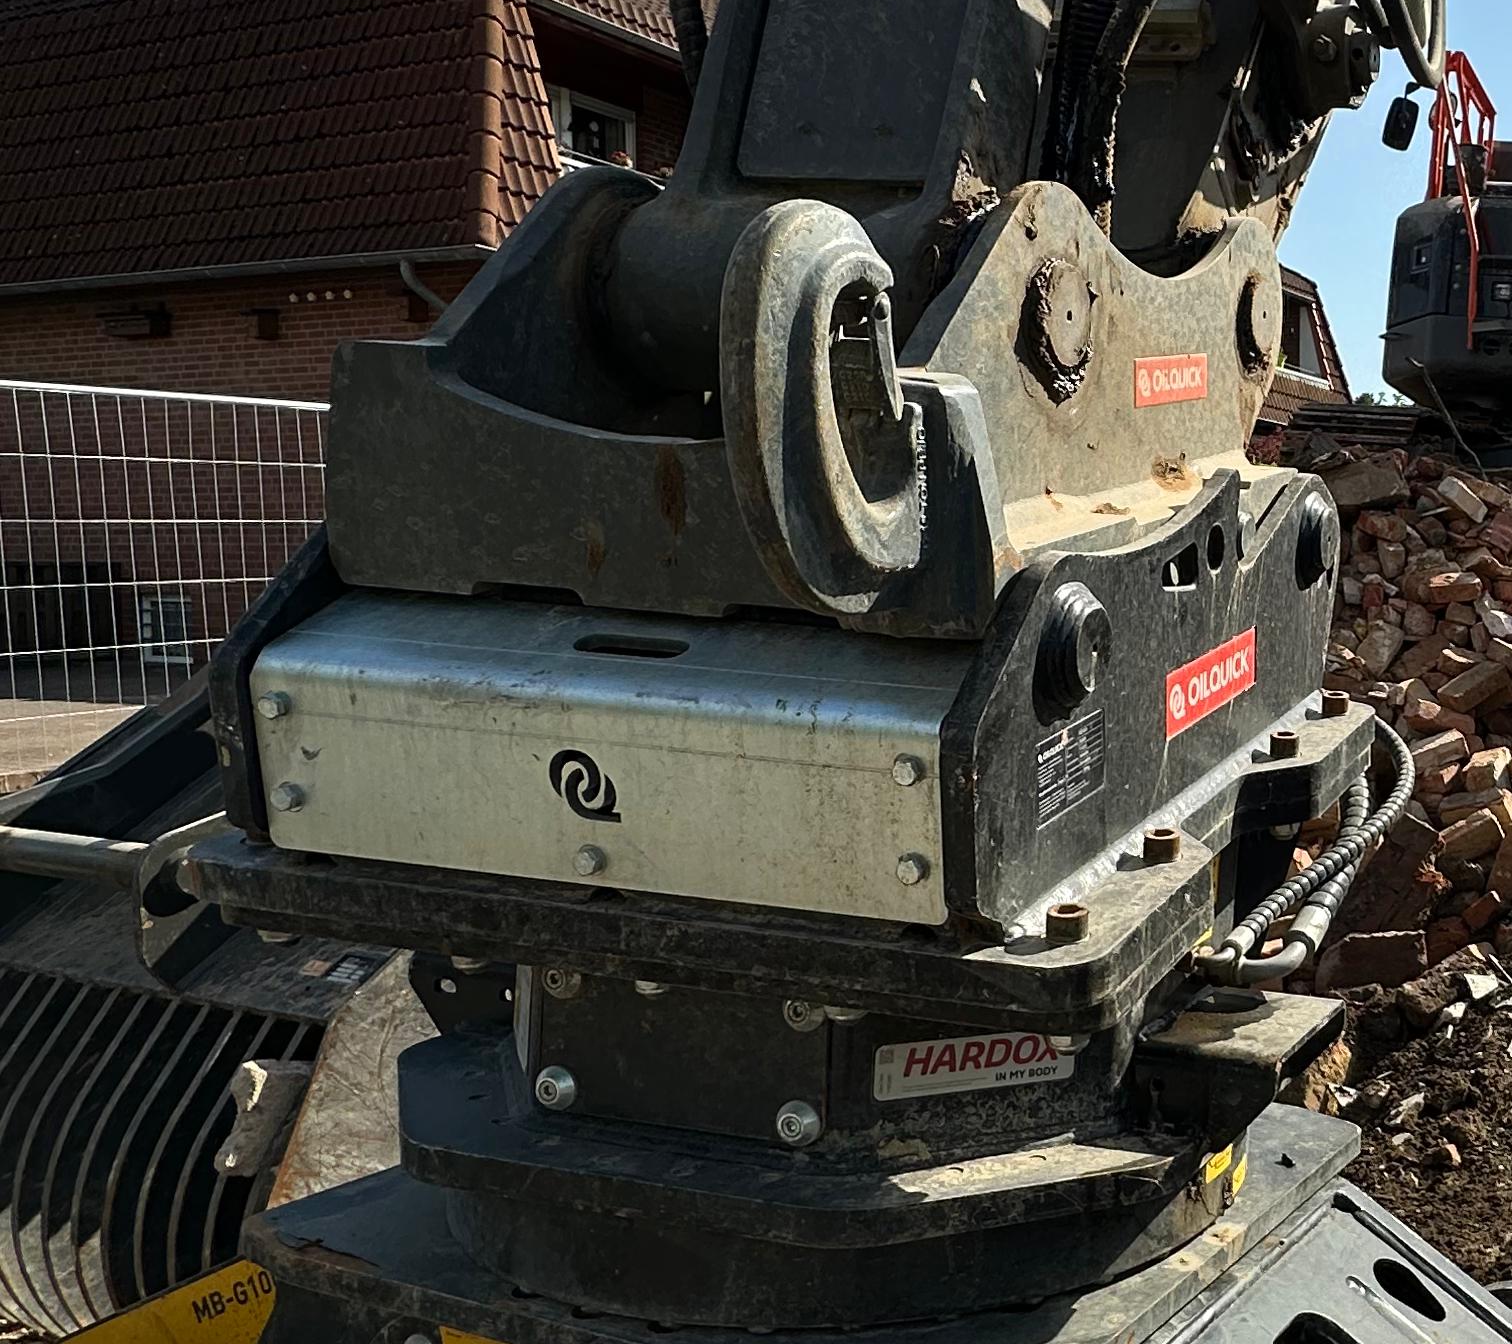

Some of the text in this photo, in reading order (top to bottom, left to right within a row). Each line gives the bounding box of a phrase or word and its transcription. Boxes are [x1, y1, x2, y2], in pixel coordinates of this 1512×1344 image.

[1188, 647, 1250, 706] OILQUICK
[903, 1035, 1058, 1078] HARDOX
[995, 1066, 1058, 1082] IN MY BODY
